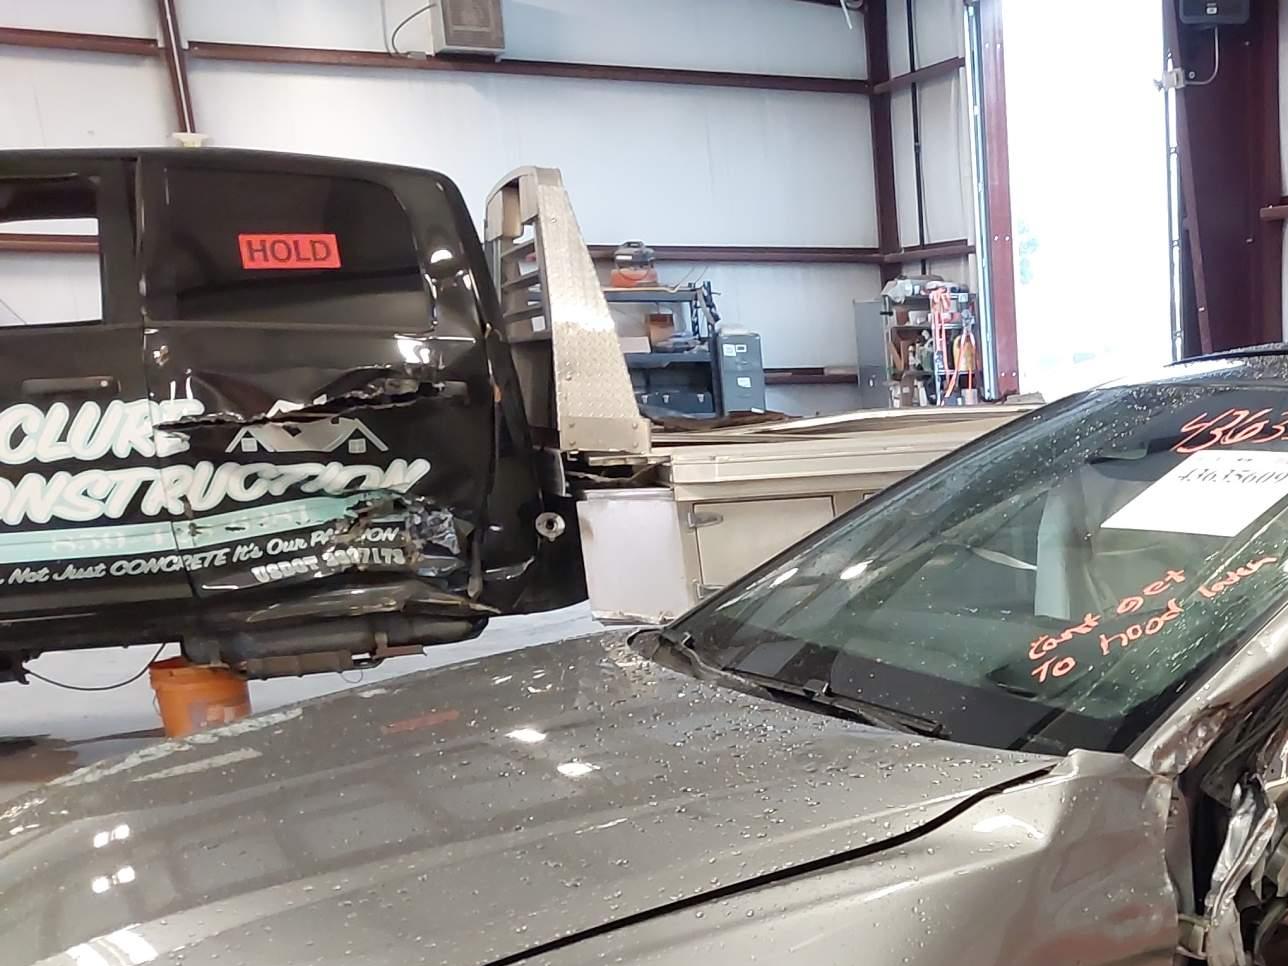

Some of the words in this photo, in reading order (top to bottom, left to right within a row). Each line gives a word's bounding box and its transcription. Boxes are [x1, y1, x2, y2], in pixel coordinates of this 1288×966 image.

[246, 239, 332, 262] HOLD
[8, 567, 50, 584] Not
[52, 564, 107, 580] Just
[110, 547, 231, 575] CONCRETE
[232, 541, 263, 563] It's
[251, 555, 319, 583] USDOT
